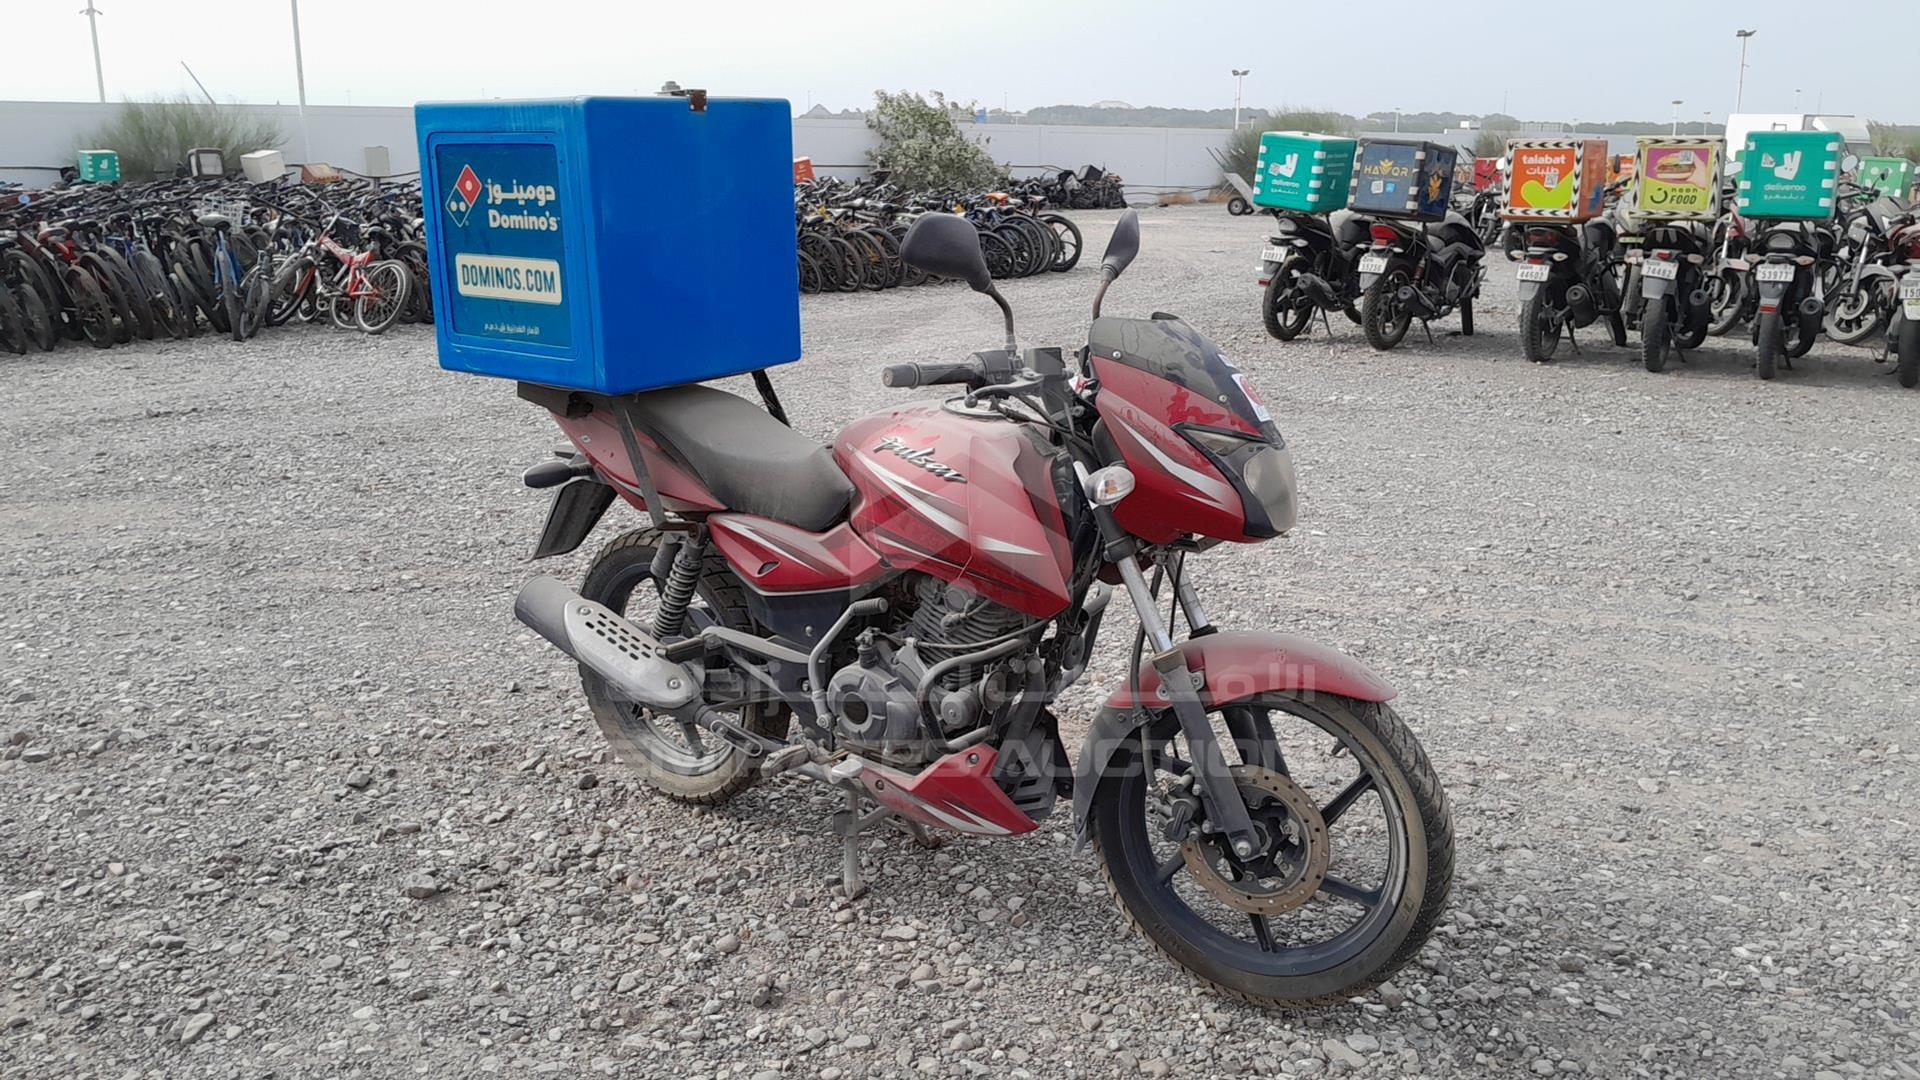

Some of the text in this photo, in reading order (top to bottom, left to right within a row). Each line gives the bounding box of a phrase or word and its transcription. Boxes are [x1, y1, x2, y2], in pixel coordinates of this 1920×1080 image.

[1522, 154, 1567, 165] talabat
[487, 178, 556, 206] دومينوز
[1764, 183, 1807, 191] deliveroo
[1669, 194, 1697, 205] FOOD
[488, 209, 558, 231] Domino's
[461, 264, 556, 294] DOMINOS.COM
